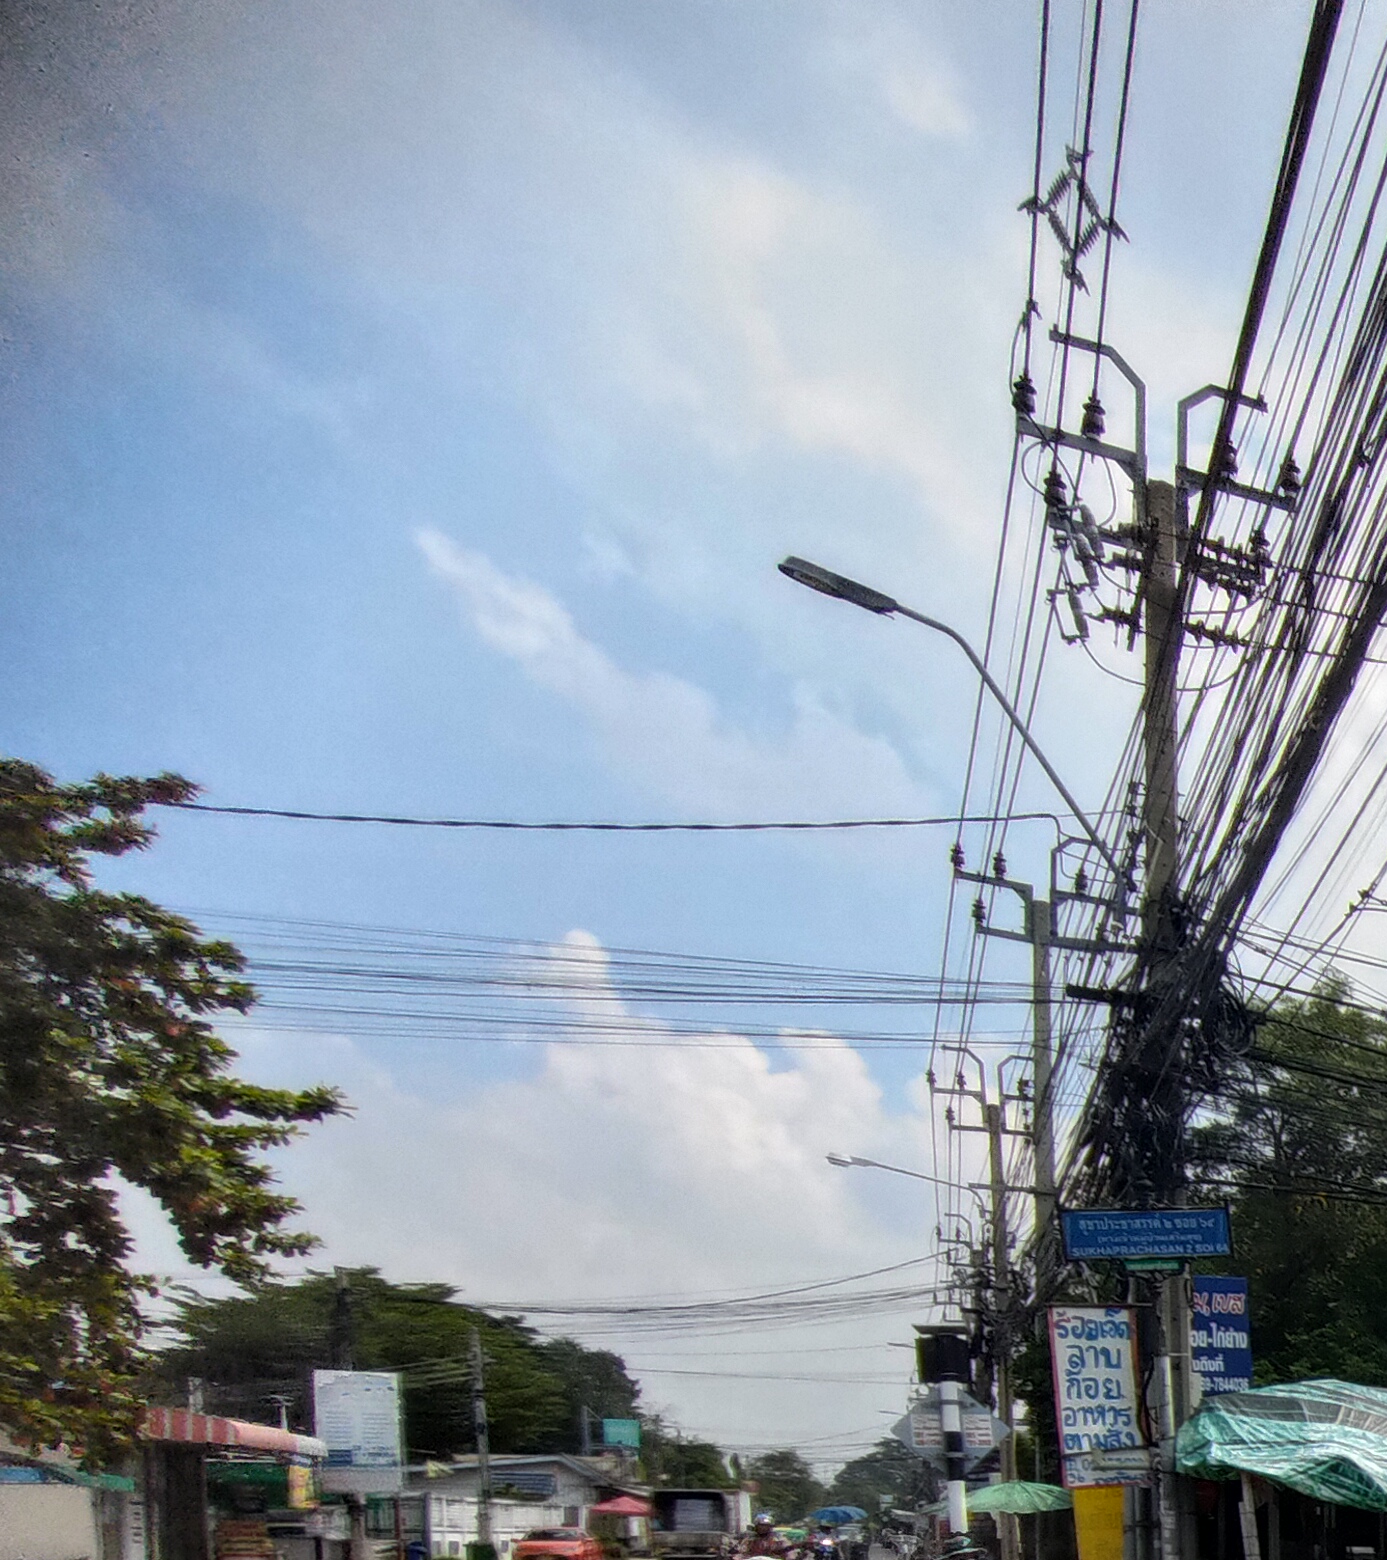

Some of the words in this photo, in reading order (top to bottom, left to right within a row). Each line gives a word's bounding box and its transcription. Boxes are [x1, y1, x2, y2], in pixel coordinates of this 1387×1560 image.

[1072, 1245, 1184, 1258] SUKHAPRACHASAN
[1186, 1245, 1193, 1253] 2
[1195, 1243, 1214, 1254] SOI
[1190, 1321, 1248, 1349] อย-ไก่ย่าง
[1065, 1344, 1122, 1369] ลาบ
[1065, 1368, 1127, 1400] ก้อย
